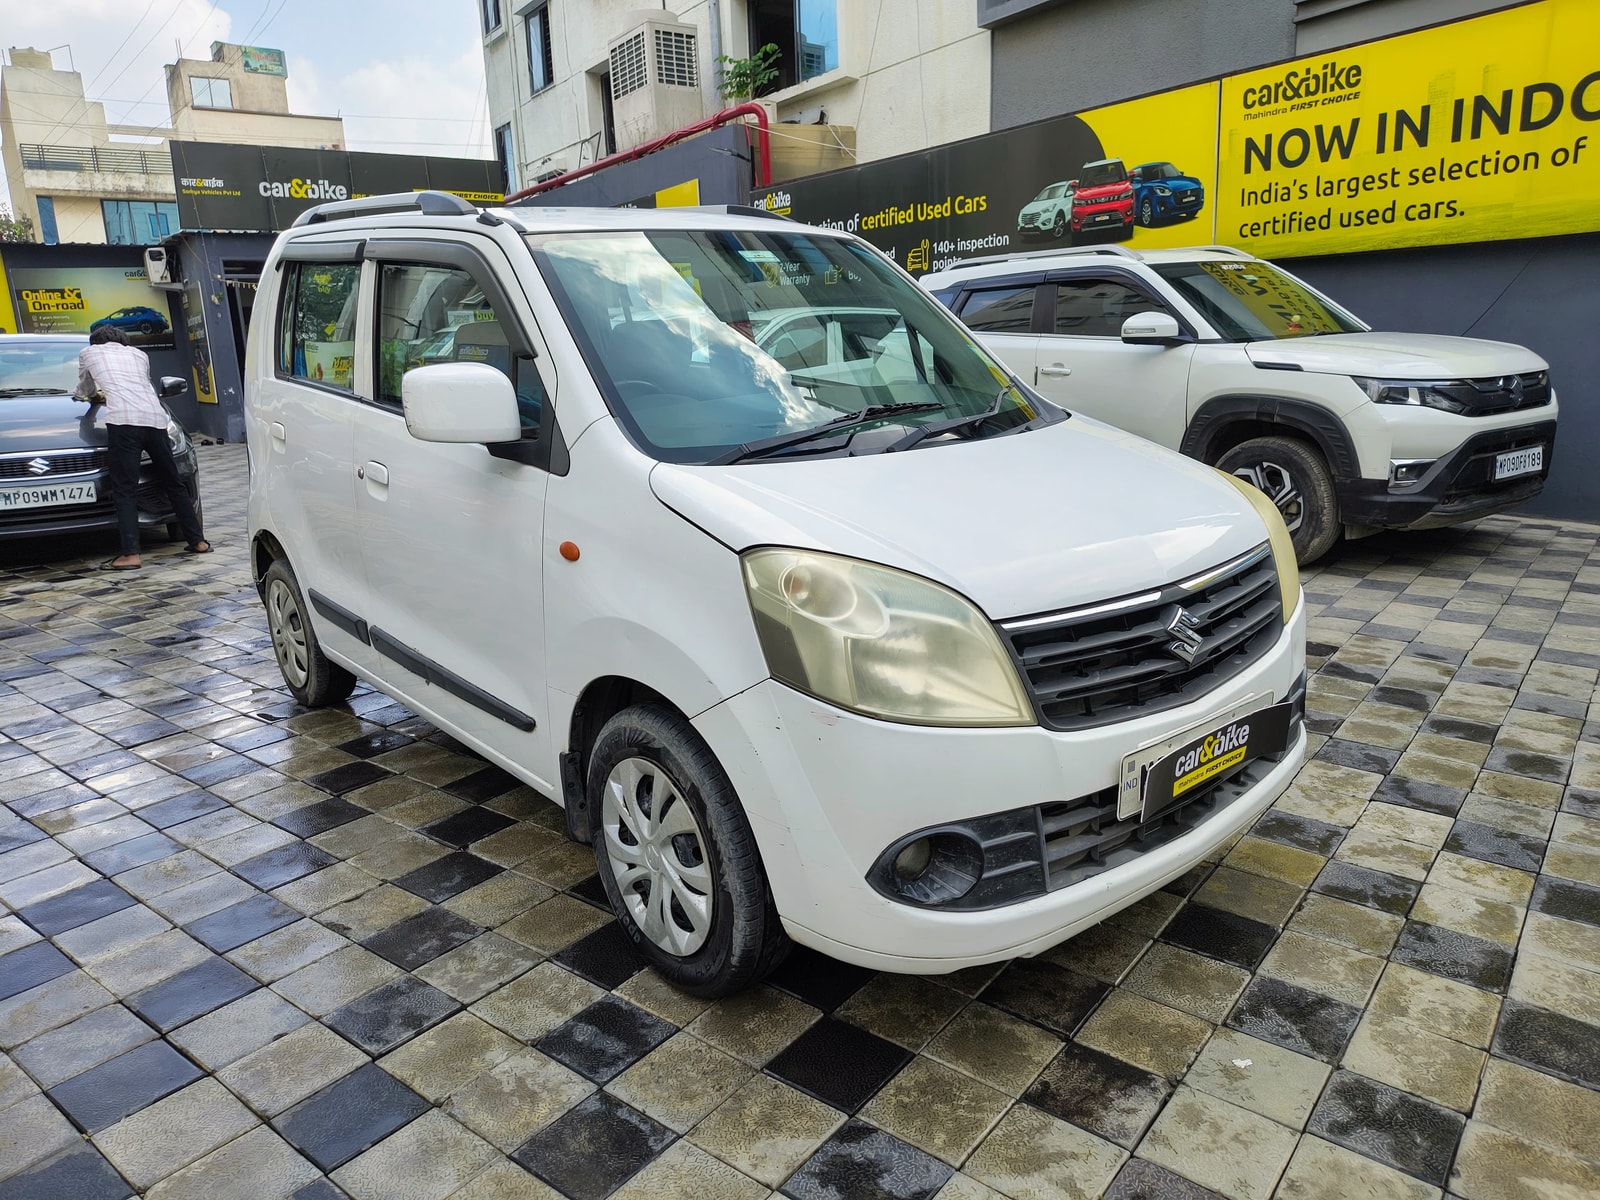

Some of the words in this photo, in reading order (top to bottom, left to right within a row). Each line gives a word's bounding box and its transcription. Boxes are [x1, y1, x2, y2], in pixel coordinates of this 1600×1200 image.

[1243, 62, 1362, 110] car&bike
[1290, 100, 1320, 112] FIRST
[1321, 92, 1360, 106] CHOICE
[1243, 117, 1360, 175] NOW
[1375, 104, 1431, 155] IN
[1241, 179, 1308, 207] India's
[1315, 166, 1400, 199] largest
[1407, 150, 1540, 187] selection
[1550, 135, 1589, 167] of
[259, 178, 347, 200] car&bike
[754, 191, 791, 211] car&bike
[847, 213, 860, 232] of
[862, 206, 914, 231] certified
[917, 197, 951, 221] Used
[954, 194, 987, 215] Cars
[1239, 207, 1331, 238] certified
[1339, 200, 1397, 229] used
[1404, 199, 1465, 223] cars.
[932, 242, 955, 255] 140+
[957, 234, 1009, 252] inspection
[780, 274, 810, 286] Warranty
[22, 289, 61, 301] Online
[64, 285, 81, 300] &
[32, 299, 85, 311] On-road
[3, 486, 94, 505] MP09WM1474
[1175, 724, 1250, 778] car&bike
[1205, 761, 1222, 775] FIRST
[1222, 751, 1243, 766] CHOICE
[1123, 777, 1138, 793] IND
